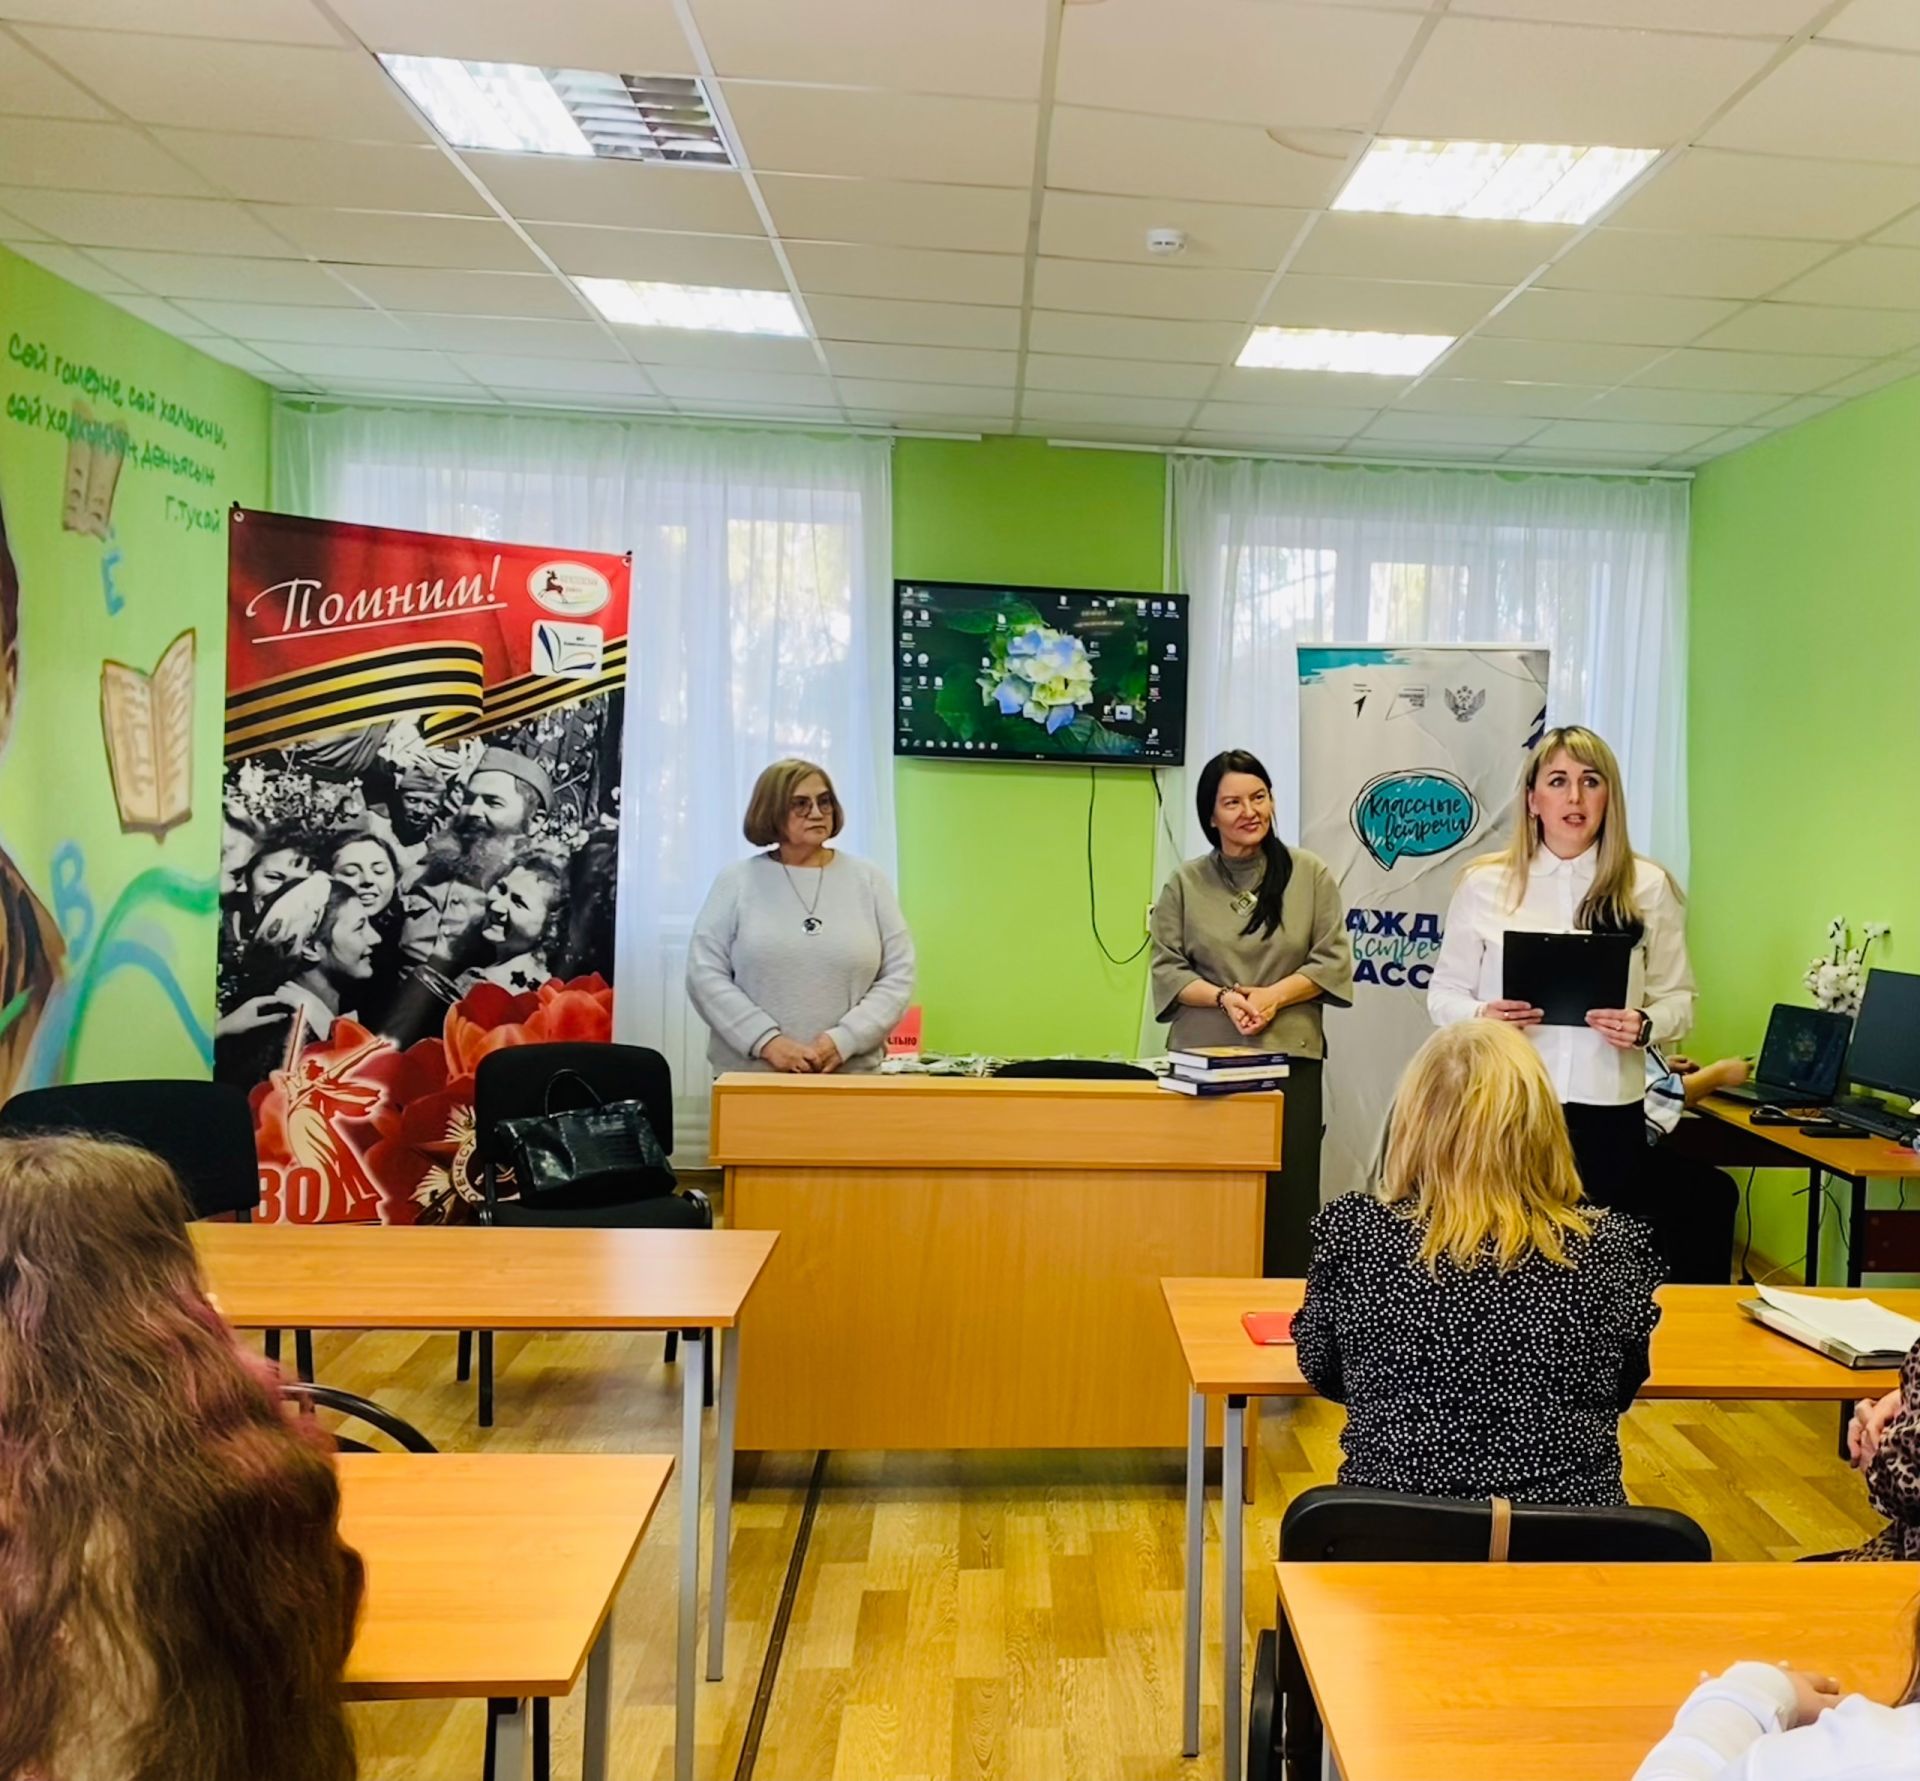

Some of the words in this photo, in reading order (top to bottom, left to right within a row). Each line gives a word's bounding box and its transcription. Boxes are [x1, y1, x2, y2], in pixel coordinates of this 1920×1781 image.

[246, 554, 502, 633] Помним!
[1384, 813, 1468, 853] встречи
[1345, 908, 1445, 942] АЖД
